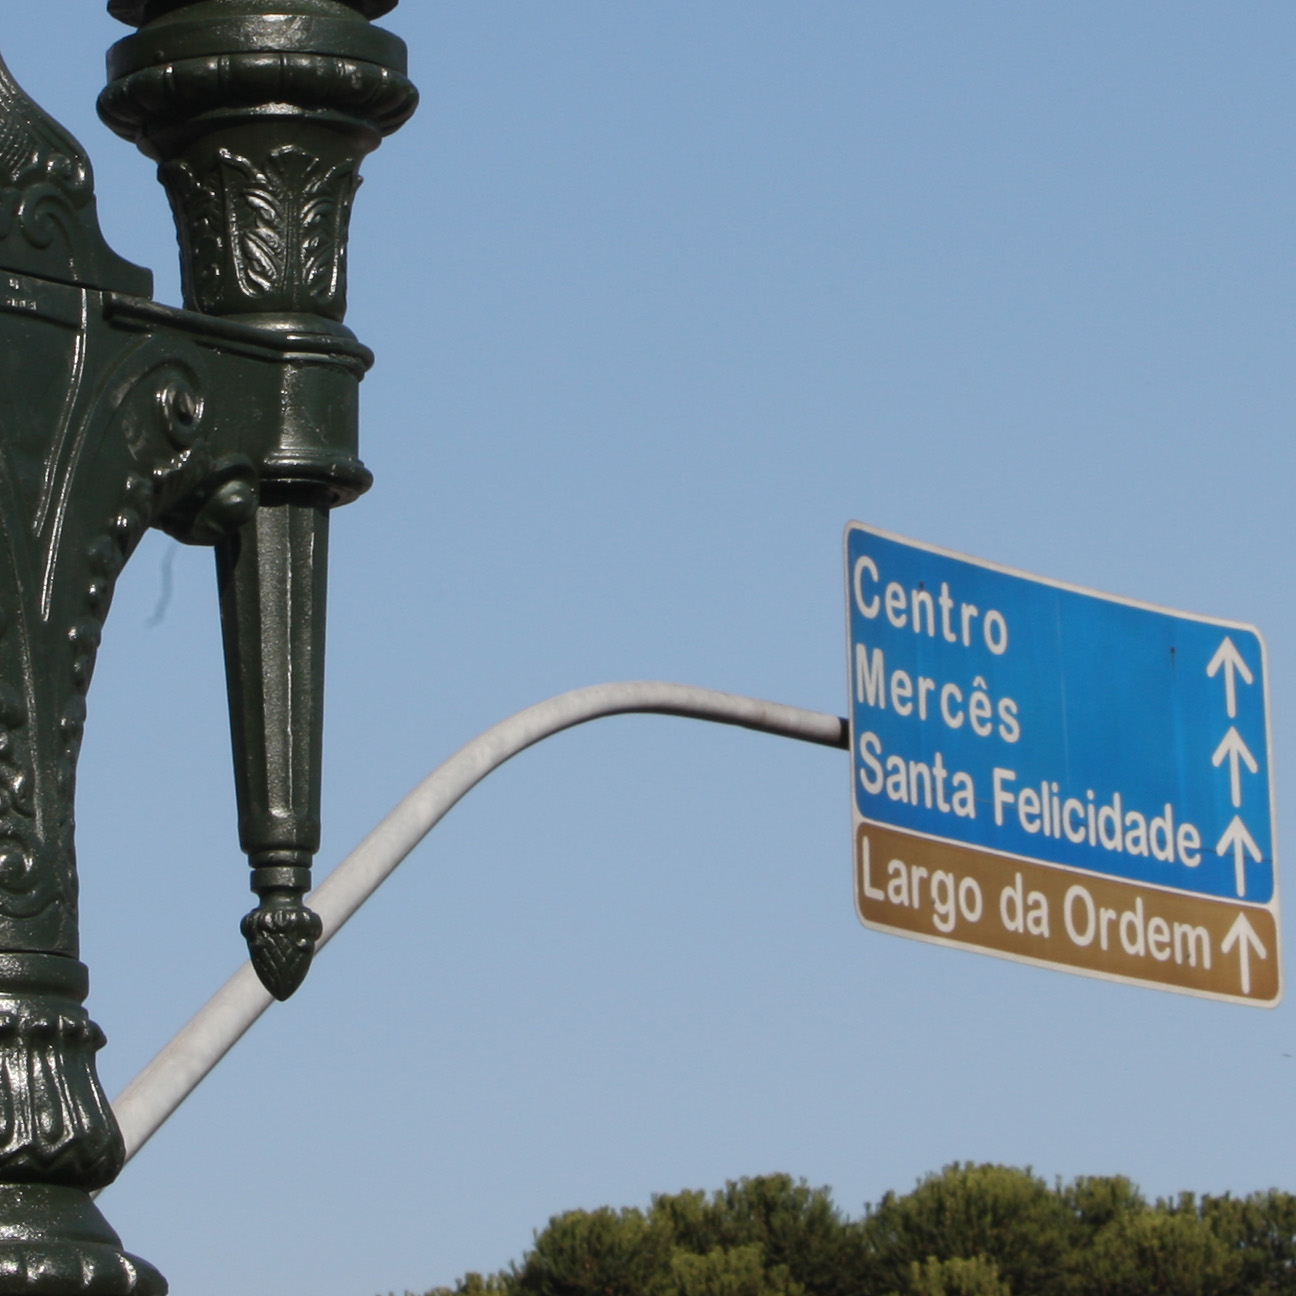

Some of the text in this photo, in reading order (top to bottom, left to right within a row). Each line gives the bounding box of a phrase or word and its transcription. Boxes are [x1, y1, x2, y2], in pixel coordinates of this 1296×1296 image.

[854, 555, 1008, 655] Centro
[855, 643, 1021, 743] Mercês
[859, 731, 1201, 868] Santa Felicidade
[861, 835, 1211, 969] Largo da Ordem
